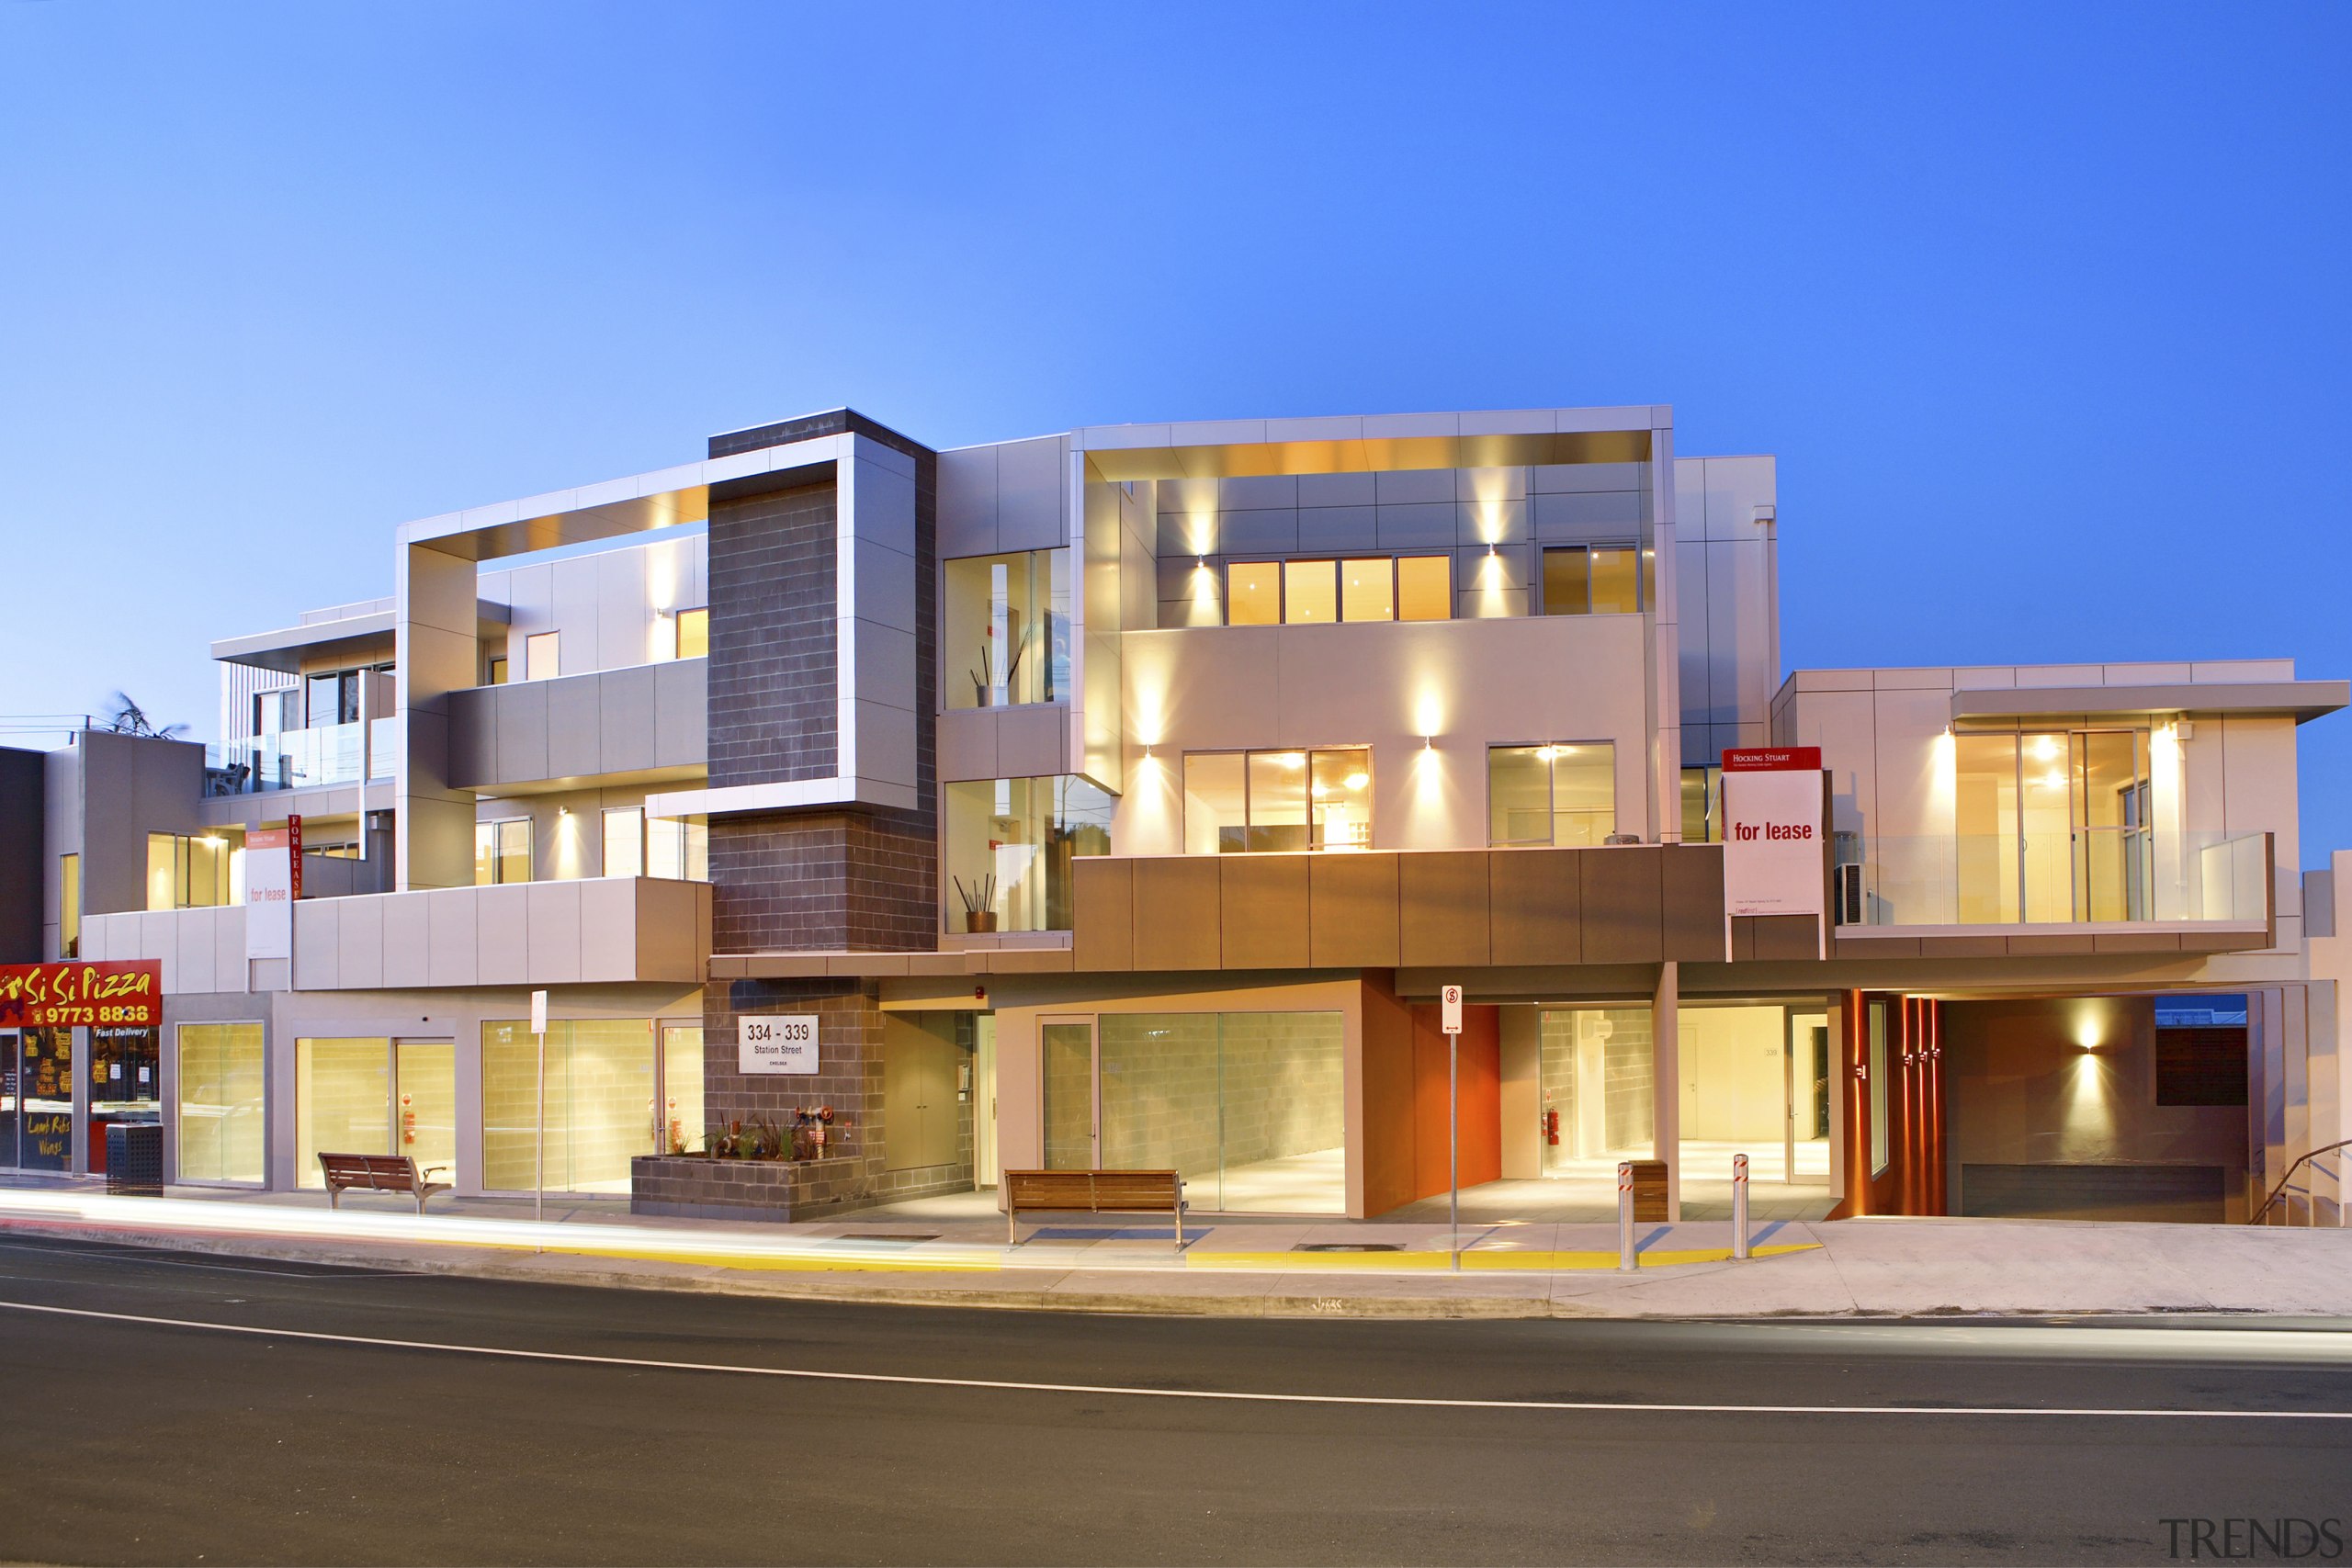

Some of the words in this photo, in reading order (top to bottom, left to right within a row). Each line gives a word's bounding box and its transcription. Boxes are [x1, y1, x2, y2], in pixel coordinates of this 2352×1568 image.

[291, 816, 300, 845] FOR
[1735, 822, 1760, 840] for
[1765, 822, 1813, 840] lease
[251, 888, 264, 902] for
[265, 887, 287, 901] lease
[24, 966, 46, 1005] Si
[52, 966, 75, 1006] Si
[83, 964, 151, 999] Pizza
[46, 1008, 94, 1023] 9773
[96, 1029, 113, 1037] Fast
[115, 1027, 149, 1038] Delivery
[748, 1024, 772, 1041] 334
[785, 1024, 809, 1041] 339
[754, 1045, 779, 1055] Station
[781, 1045, 802, 1055] Street
[28, 1114, 50, 1134] Lamb
[51, 1115, 71, 1134] Ribs
[39, 1140, 62, 1156] Wings
